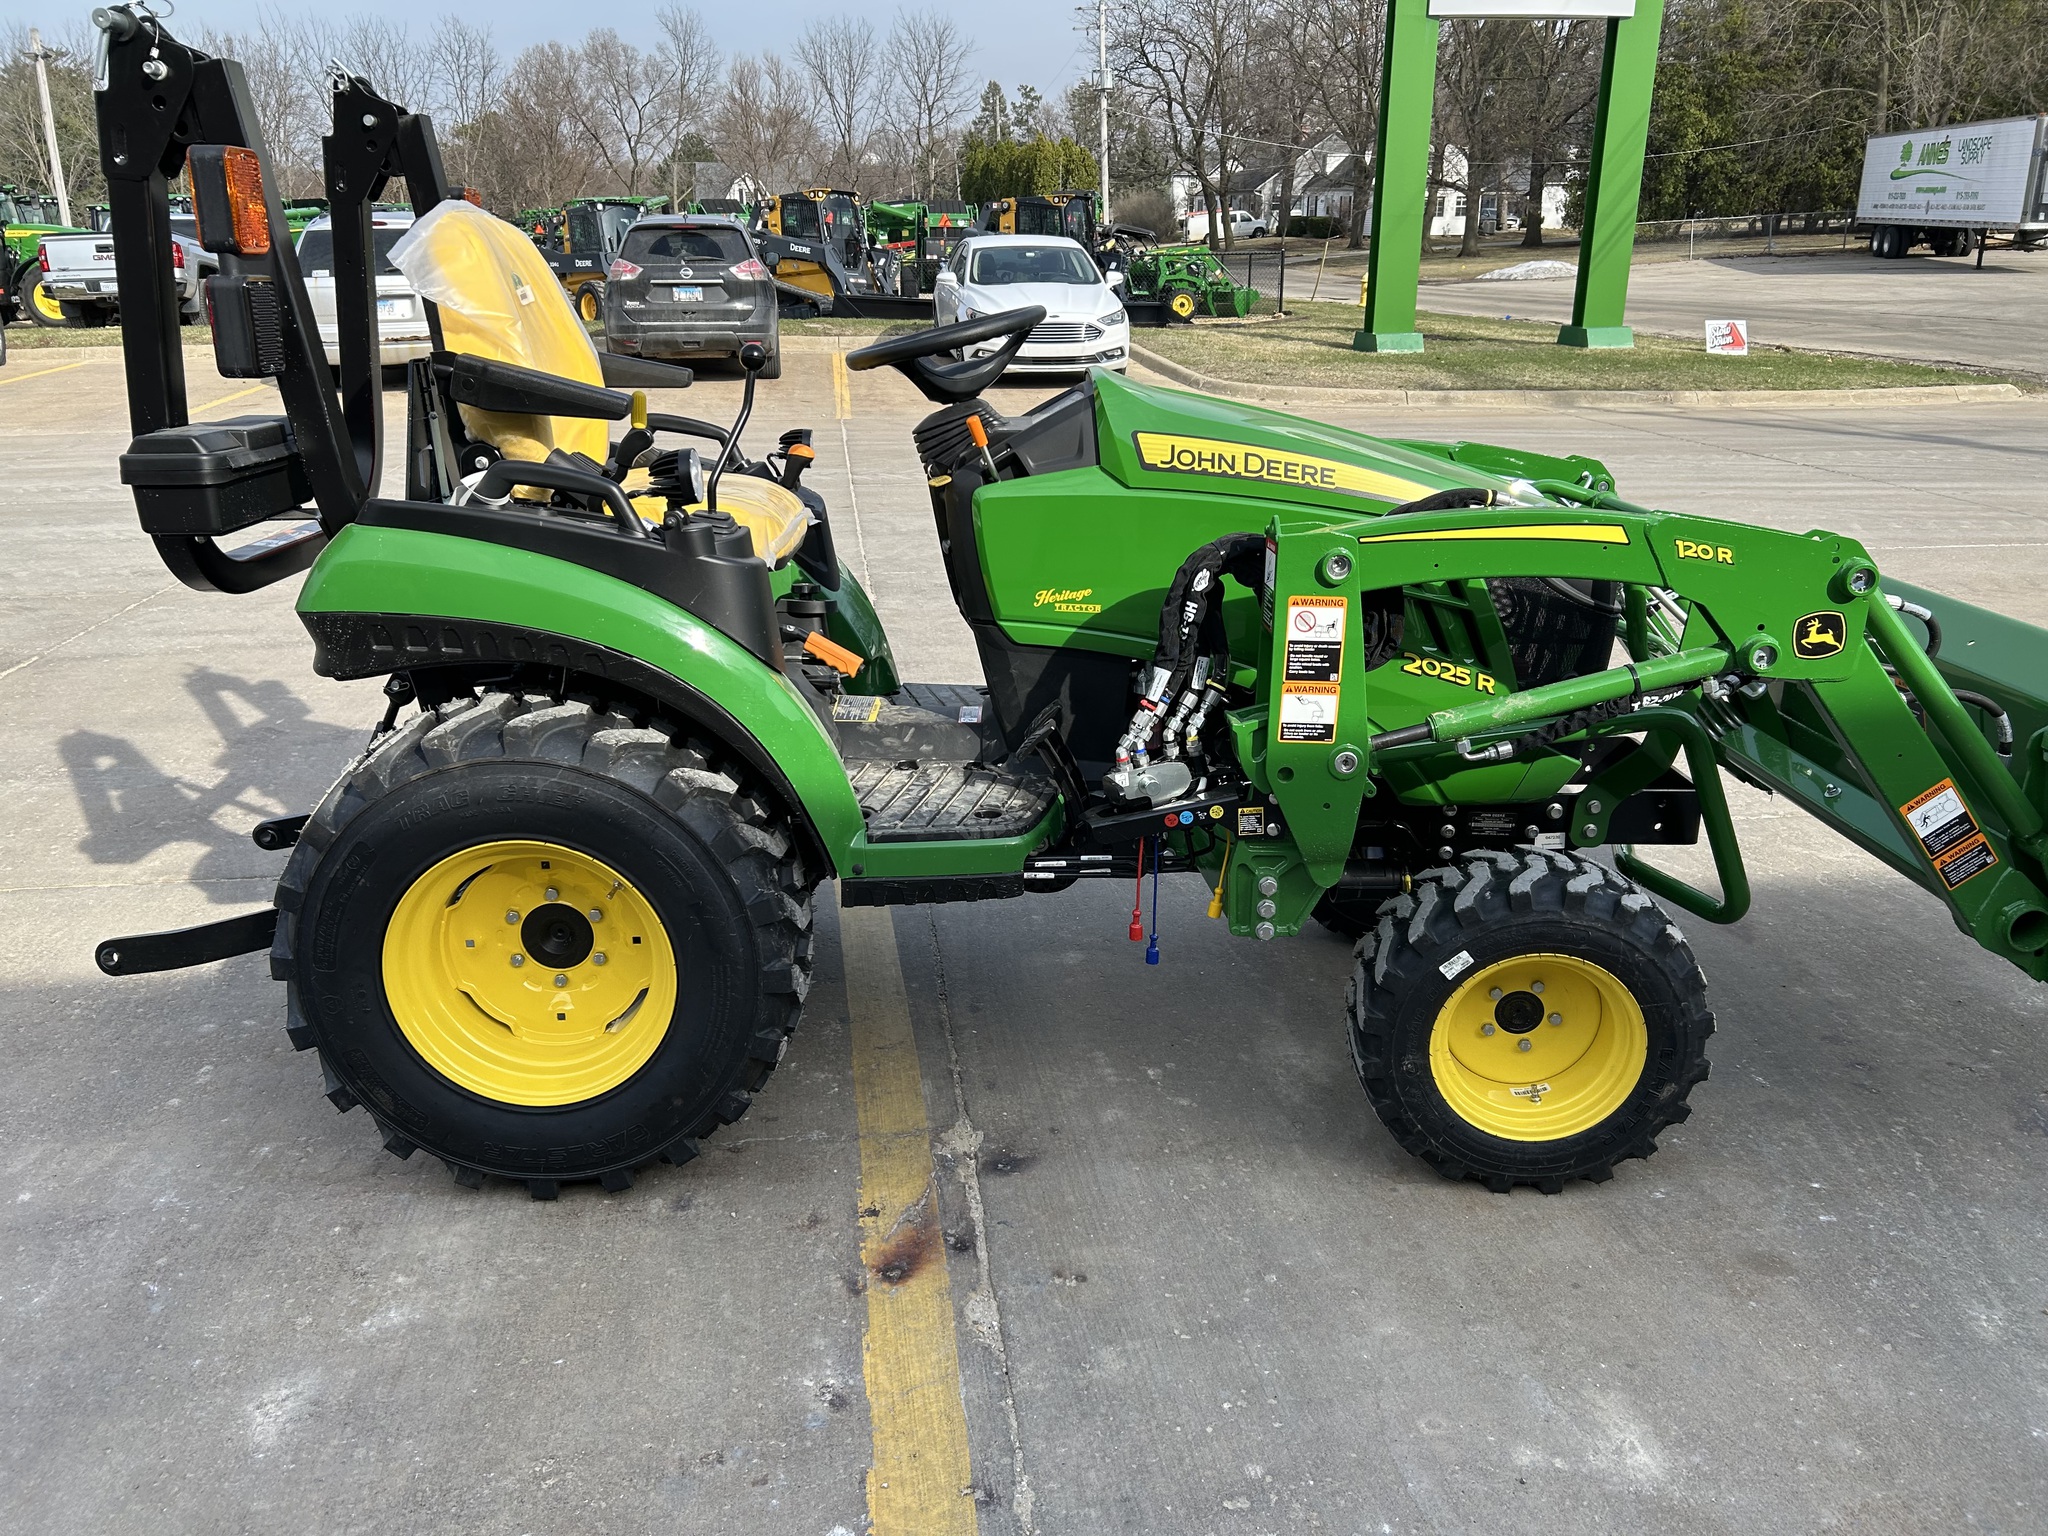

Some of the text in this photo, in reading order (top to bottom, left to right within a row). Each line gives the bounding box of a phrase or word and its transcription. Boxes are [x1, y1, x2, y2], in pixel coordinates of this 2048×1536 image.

[1958, 136, 1993, 153] LANDSCAPE
[1961, 150, 1985, 165] SUPPLY
[790, 243, 811, 254] DEERE
[575, 259, 593, 267] DEERE
[1160, 444, 1336, 486] JOHN DEERE
[1675, 539, 1735, 565] 120 R
[1034, 588, 1092, 608] Heritage
[1055, 603, 1101, 613] TRACTOR
[1300, 598, 1344, 607] WARNING
[1402, 652, 1495, 695] 2025 R
[1294, 686, 1337, 694] WARNING
[1914, 783, 1947, 806] WARNING
[394, 784, 590, 831] TRAC CHIEF
[1948, 838, 1981, 860] WARNING
[1600, 1047, 1675, 1146] CARLSTAR
[483, 1122, 650, 1164] CARLSTAR
